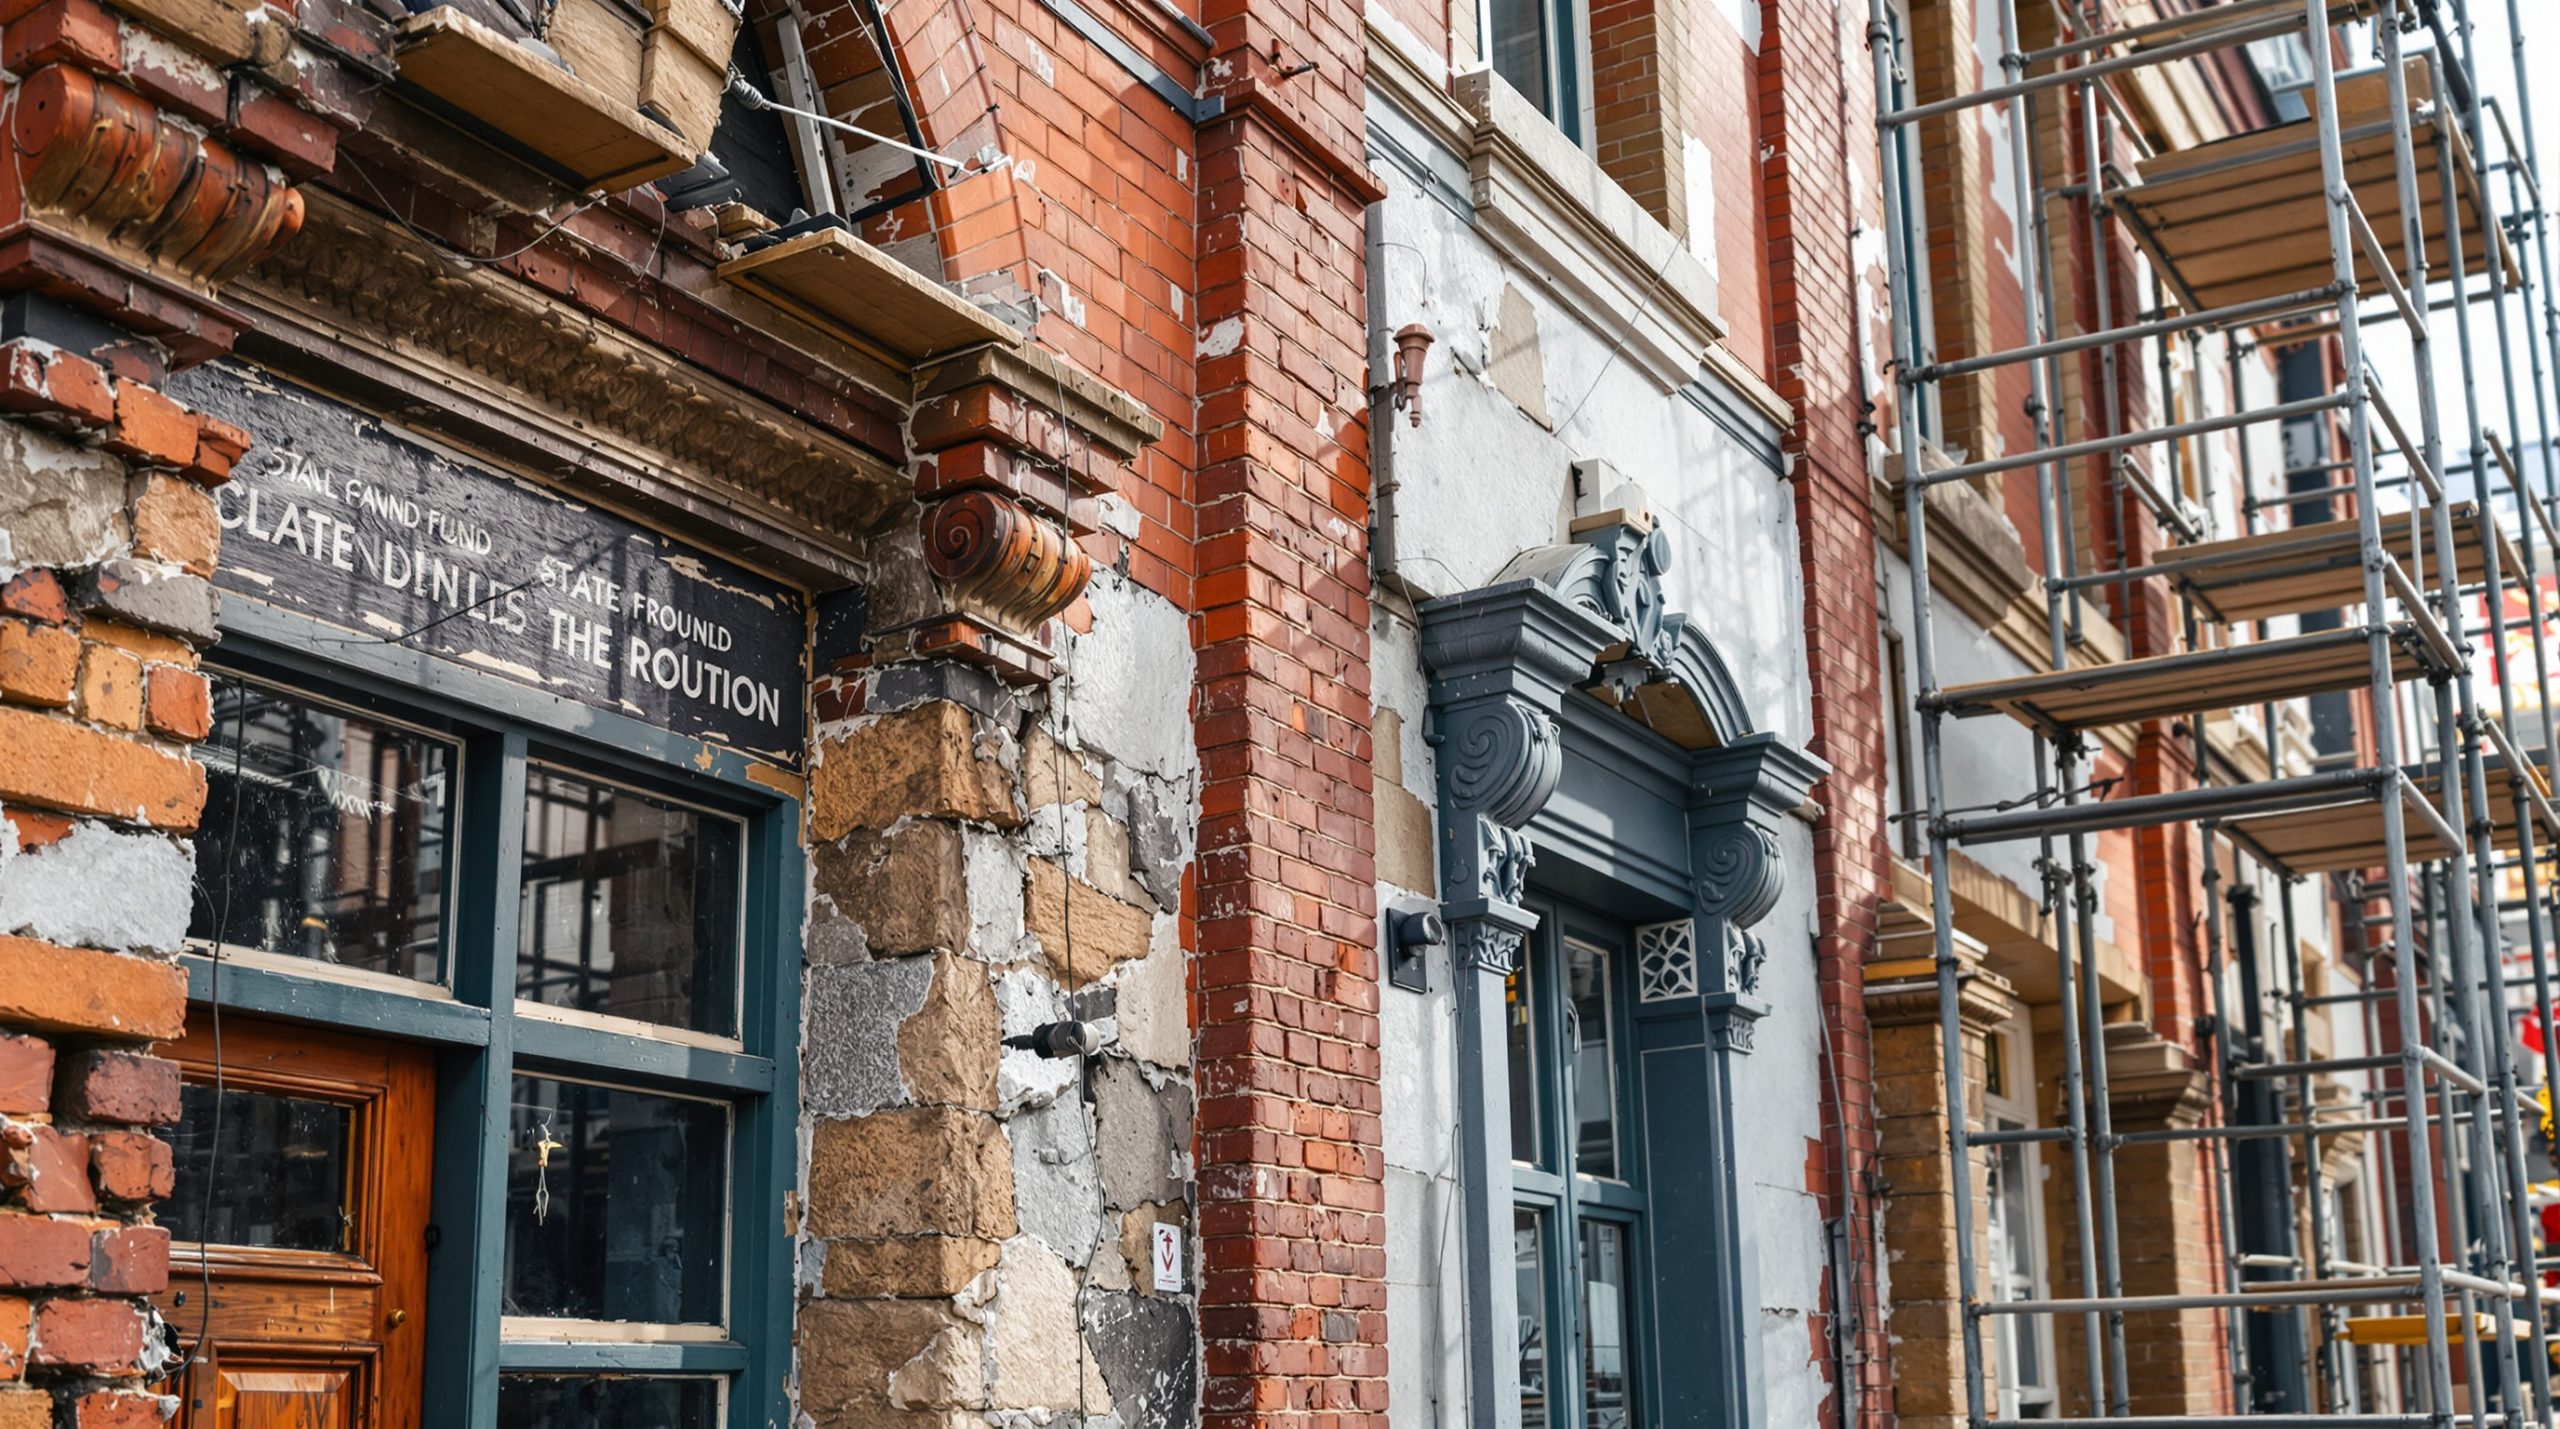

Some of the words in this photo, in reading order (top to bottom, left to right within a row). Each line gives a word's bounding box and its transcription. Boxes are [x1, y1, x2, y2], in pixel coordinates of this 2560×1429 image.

[428, 510, 492, 555] FUND
[539, 554, 621, 613] STATE
[632, 591, 732, 652] FROUNLD
[549, 607, 613, 670] THE
[630, 635, 780, 727] ROUTION
